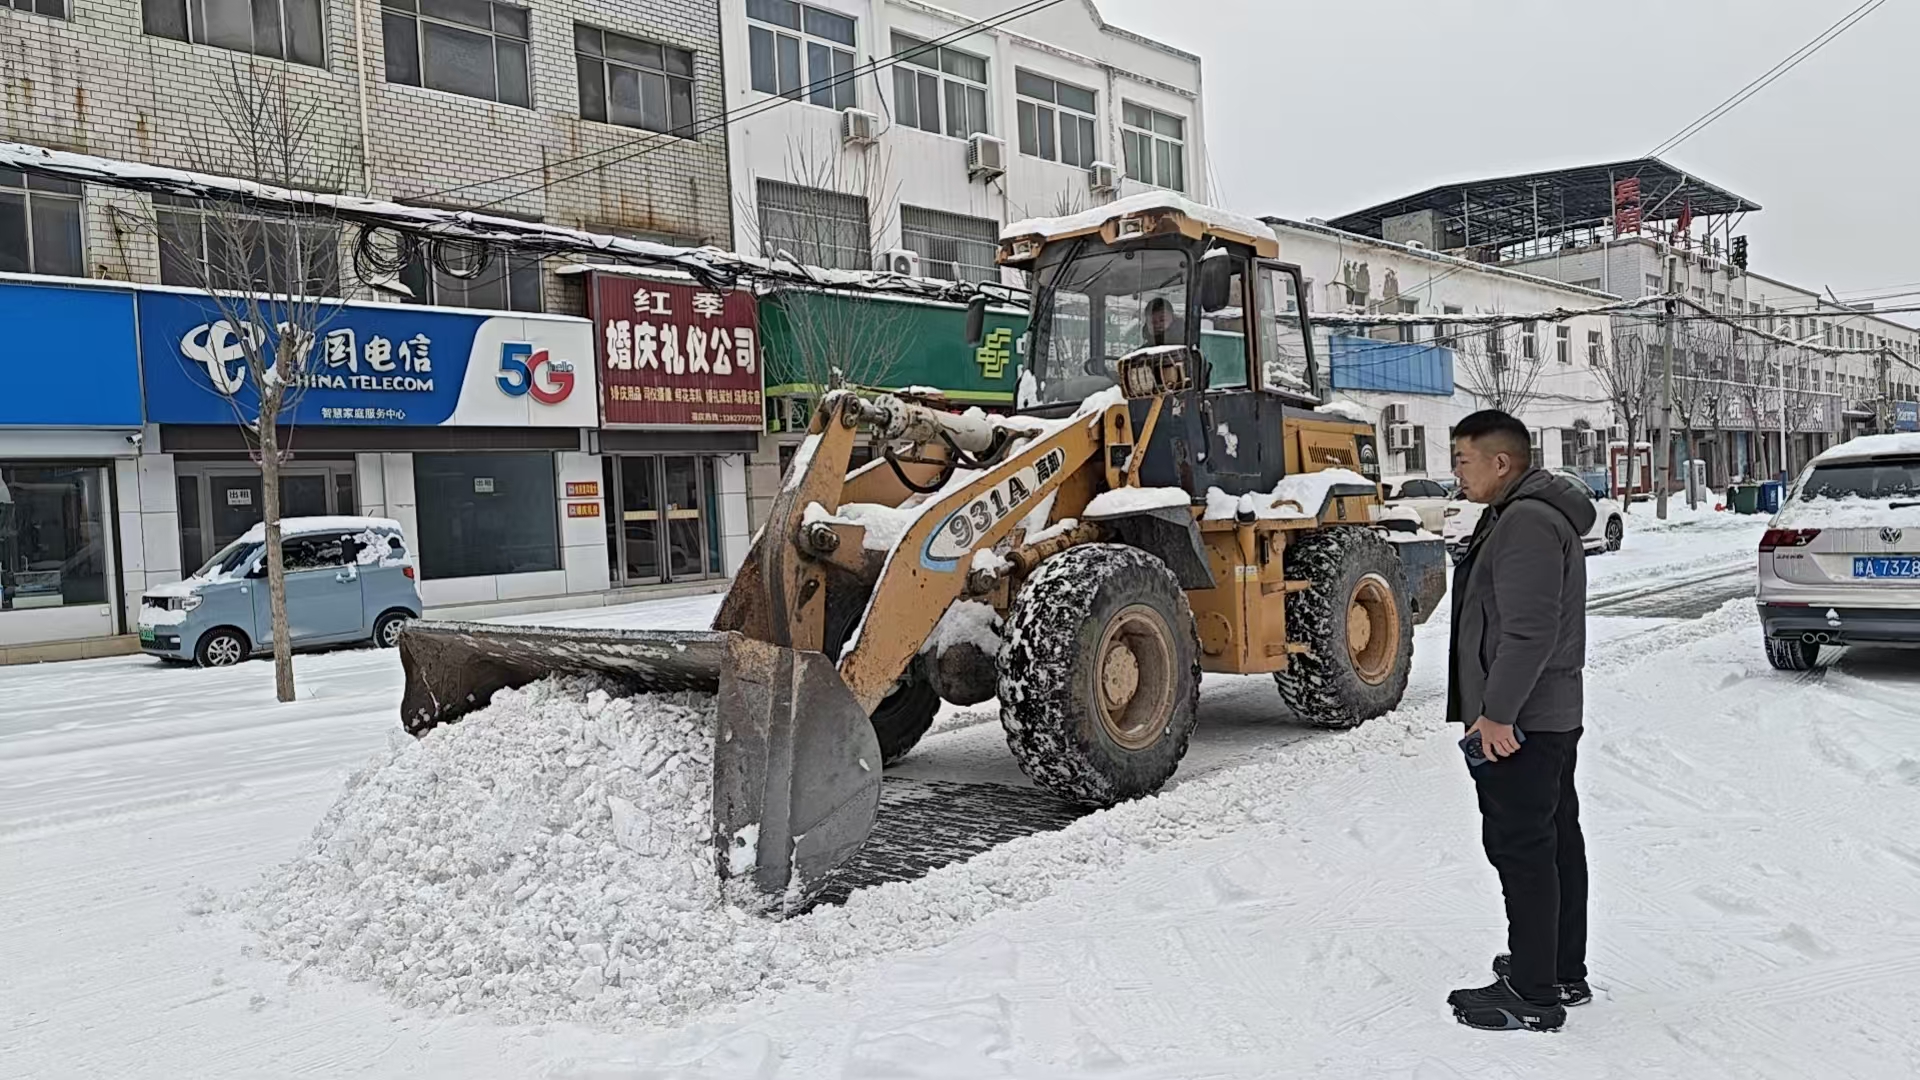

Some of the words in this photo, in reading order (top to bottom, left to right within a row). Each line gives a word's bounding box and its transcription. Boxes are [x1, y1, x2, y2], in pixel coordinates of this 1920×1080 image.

[1615, 177, 1641, 233] 宾馆
[633, 288, 724, 319] 红季
[606, 319, 755, 375] 婚庆礼仪公司
[495, 341, 575, 406] 5G
[547, 361, 574, 373] hello
[349, 375, 434, 391] TELECOM
[610, 385, 642, 401] 婚庆用品
[321, 407, 406, 420] 智慧家庭服务中心
[949, 476, 1032, 548] 931A
